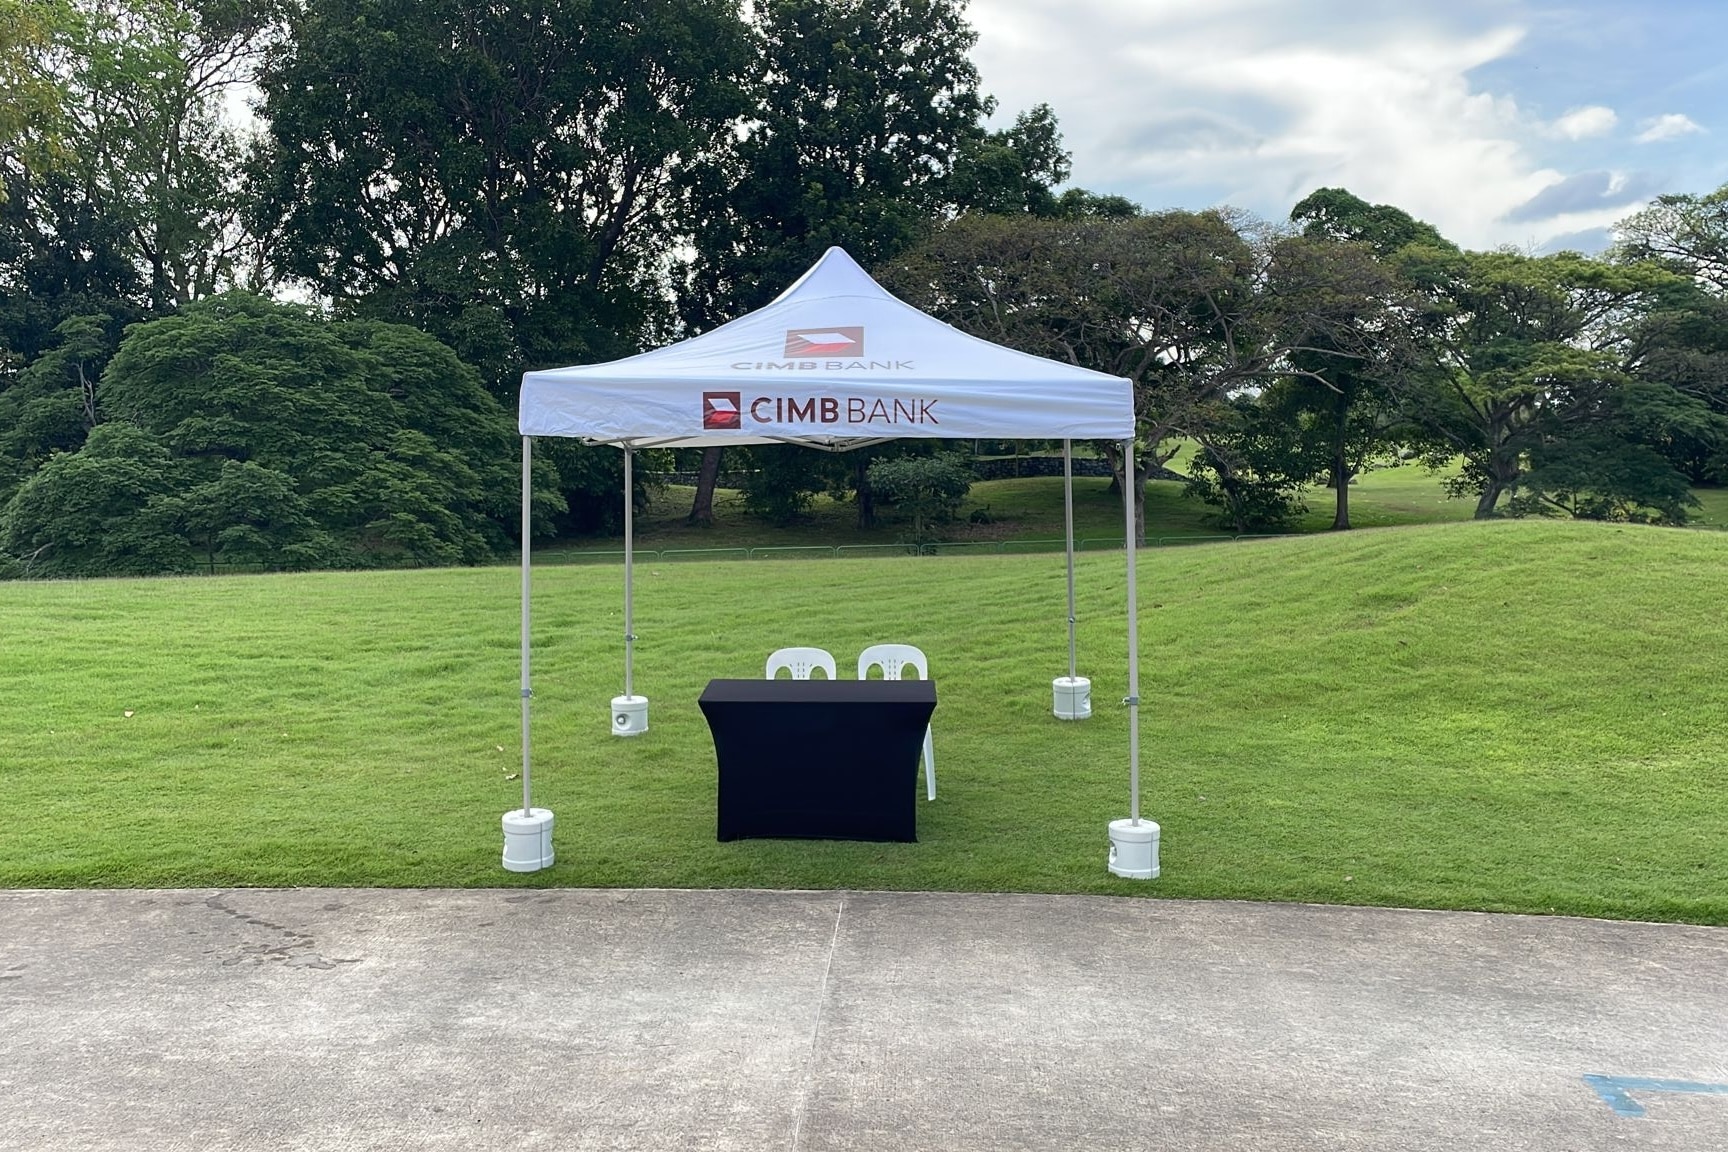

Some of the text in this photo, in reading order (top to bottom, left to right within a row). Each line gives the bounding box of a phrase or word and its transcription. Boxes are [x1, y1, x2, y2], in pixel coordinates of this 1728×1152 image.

[730, 360, 915, 370] CIMB BANK
[750, 397, 939, 424] CIMB BANK
